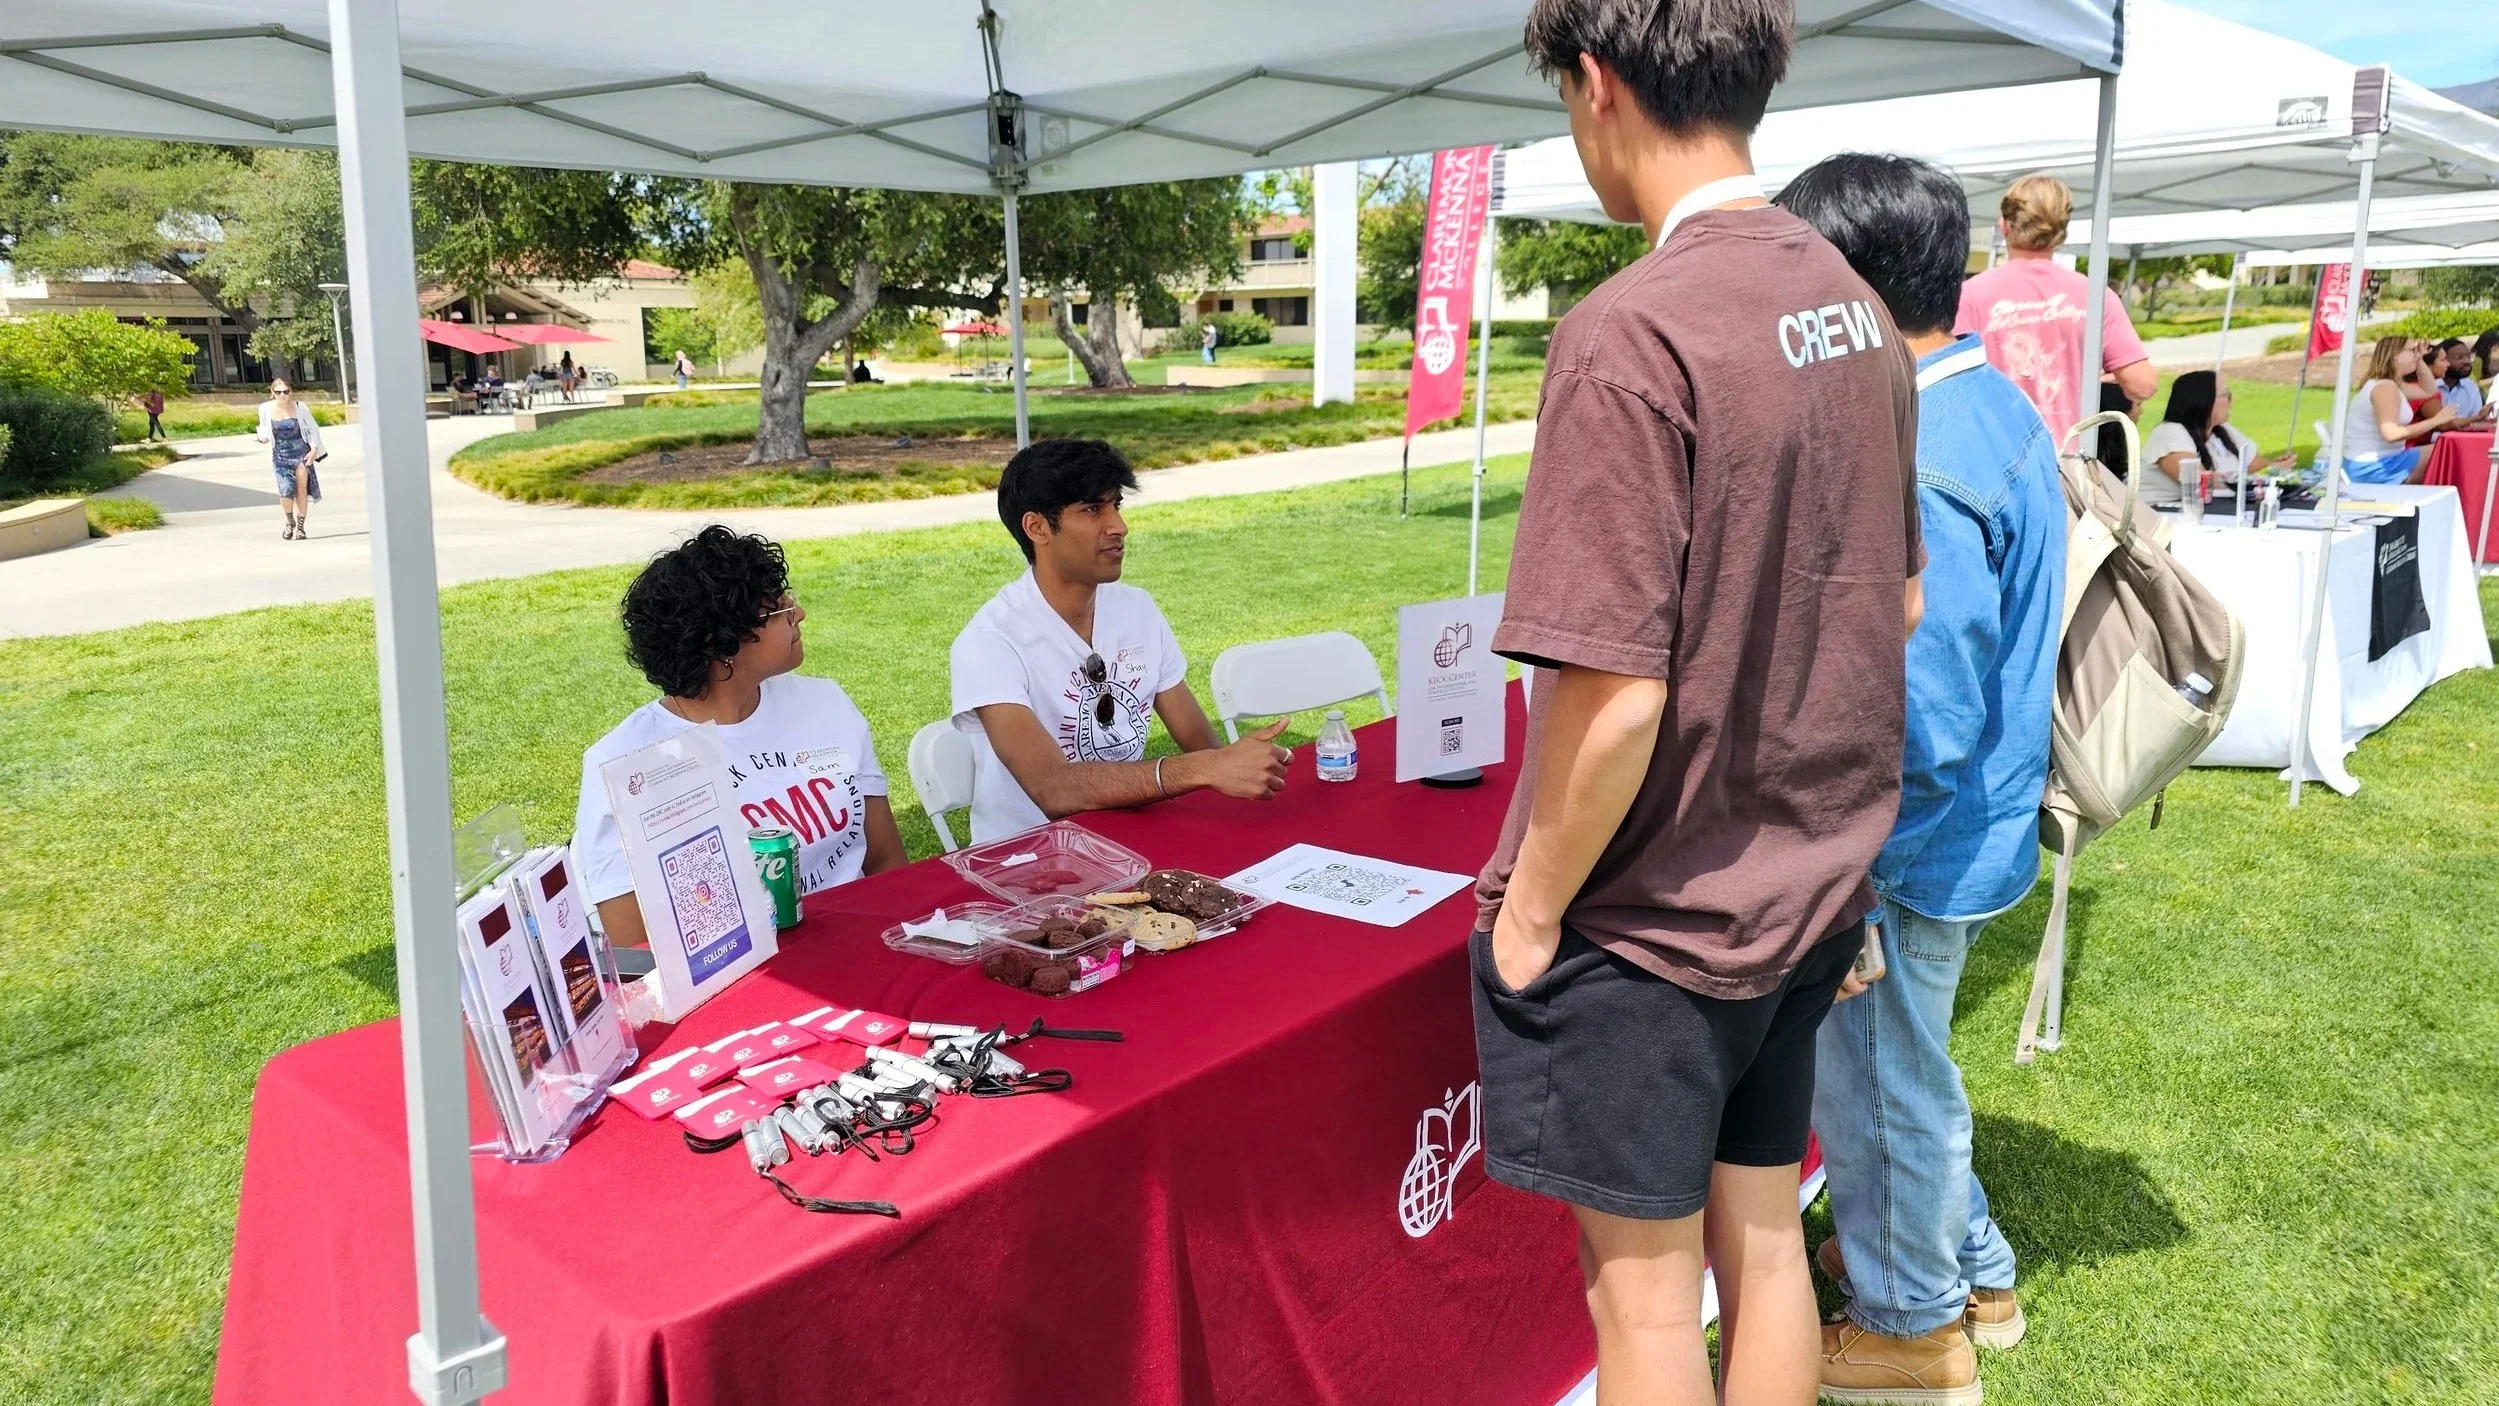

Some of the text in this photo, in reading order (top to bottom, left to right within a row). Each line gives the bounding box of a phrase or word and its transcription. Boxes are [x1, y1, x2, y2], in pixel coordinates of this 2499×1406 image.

[1425, 148, 1457, 291] CLAREMON
[1778, 300, 1884, 368] CREW
[749, 751, 797, 770] CEN
[808, 762, 841, 774] Sam
[827, 775, 864, 870] RELATIONS
[703, 938, 738, 966] FOLLOW US
